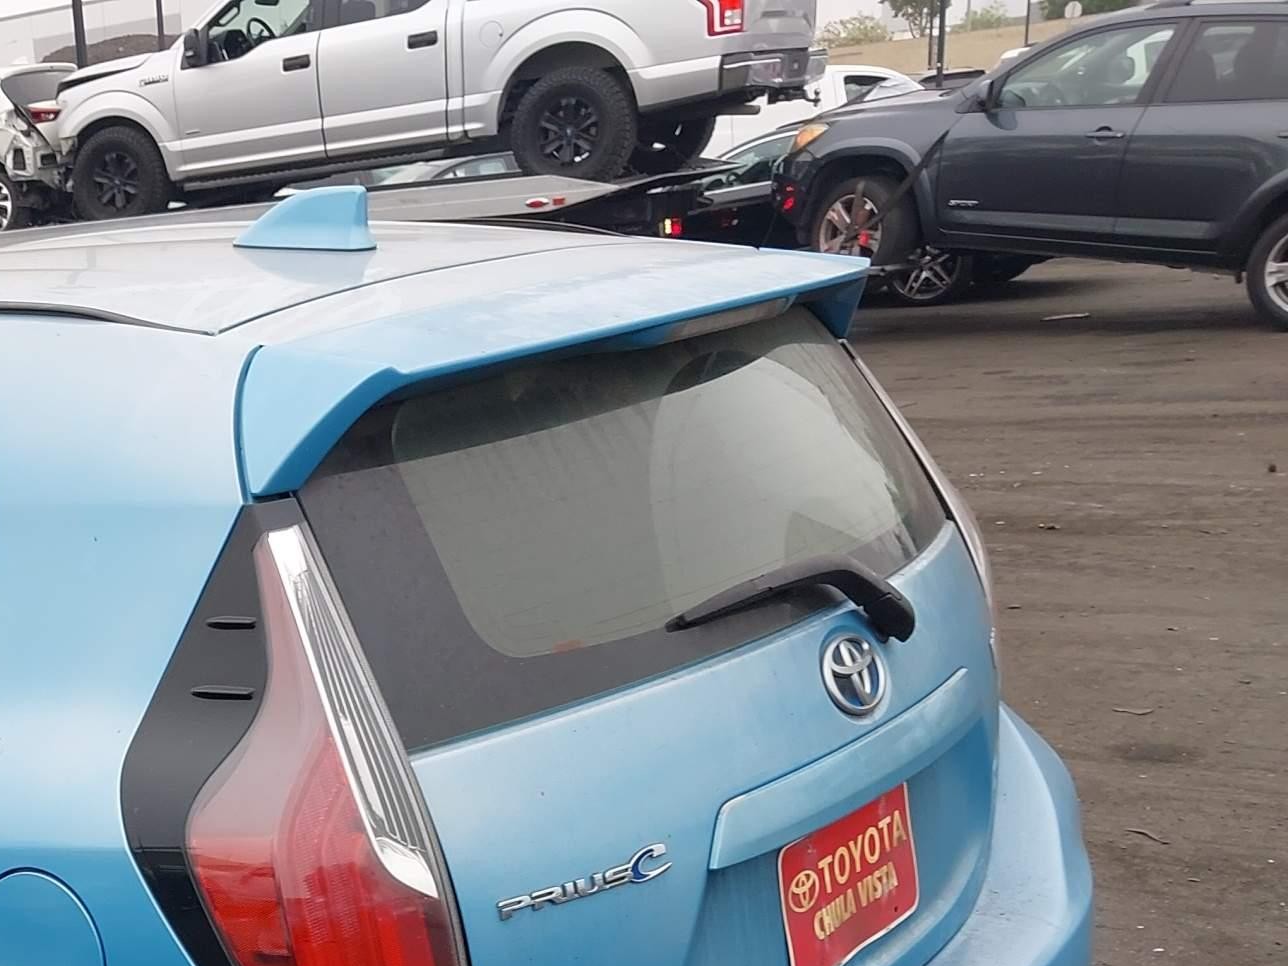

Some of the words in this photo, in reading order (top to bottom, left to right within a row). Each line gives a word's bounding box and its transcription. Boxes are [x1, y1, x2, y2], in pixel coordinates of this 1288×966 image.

[817, 809, 907, 894] TOYOTA
[496, 863, 632, 921] PRIUS
[813, 888, 857, 940] CHULA
[856, 861, 899, 908] VISTA
